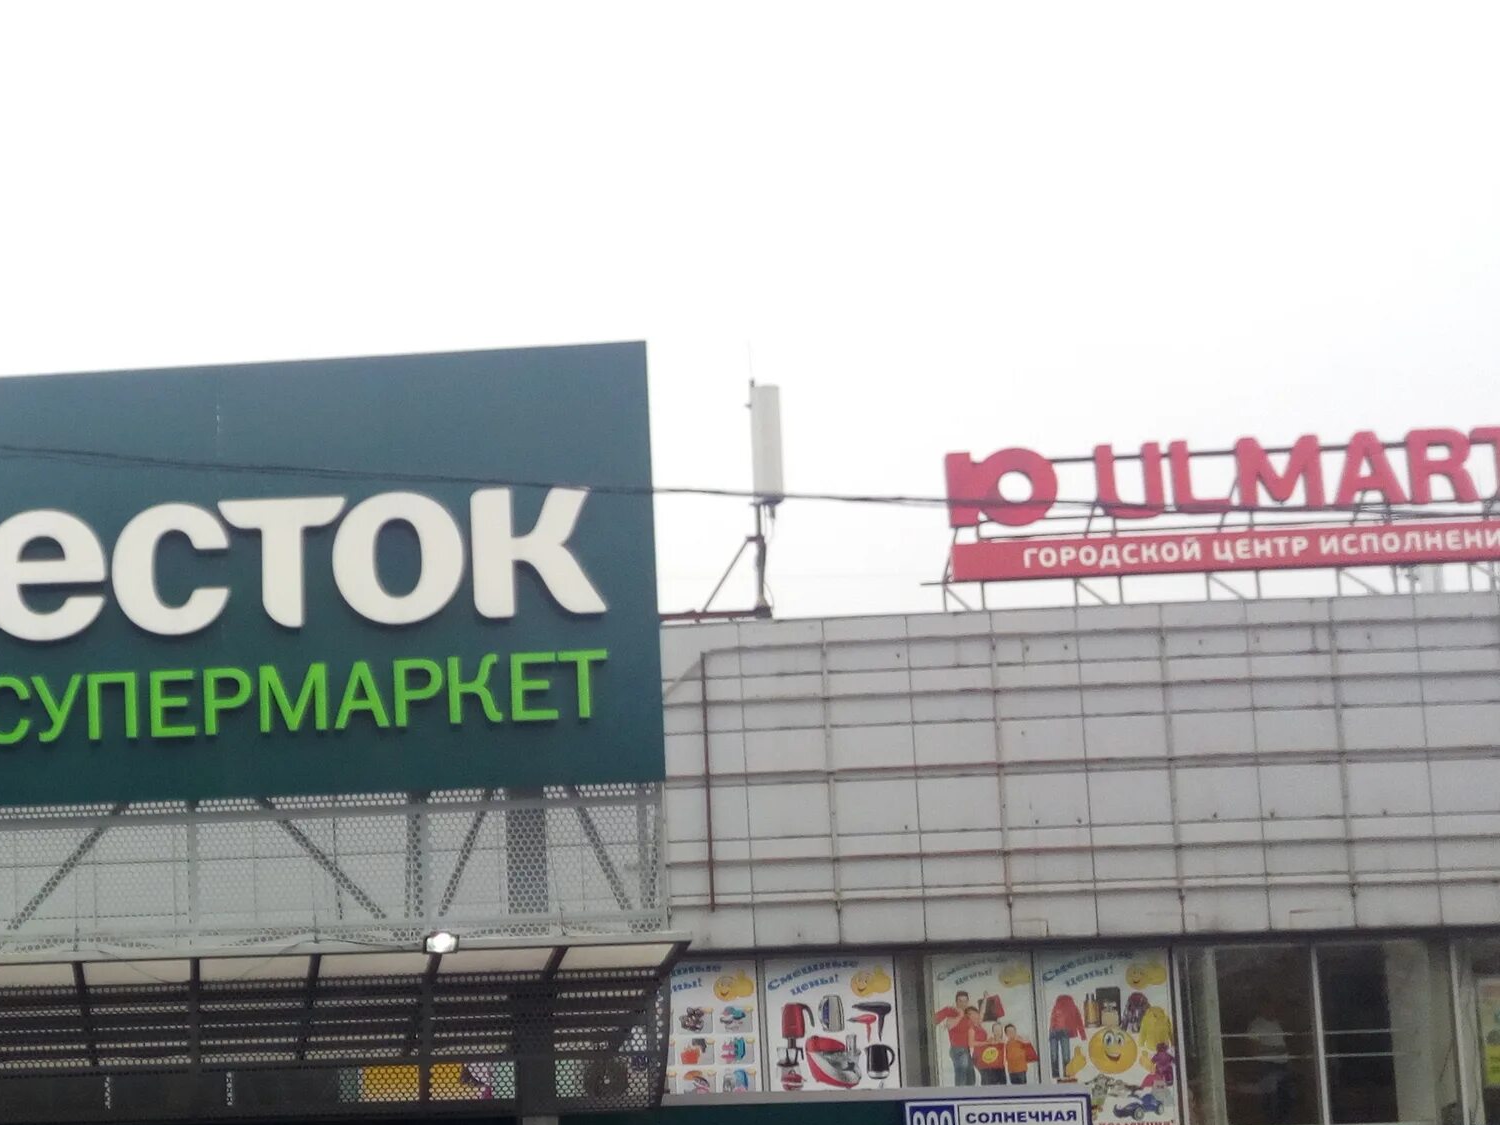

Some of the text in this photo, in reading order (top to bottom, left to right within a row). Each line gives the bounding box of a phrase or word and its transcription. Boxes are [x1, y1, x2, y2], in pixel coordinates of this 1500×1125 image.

[1022, 538, 1202, 570] ГОРОДСКОЙ
[1212, 534, 1309, 564] ЦЕНТР
[965, 1109, 1078, 1125] СОЛНЕЧНАЯ
